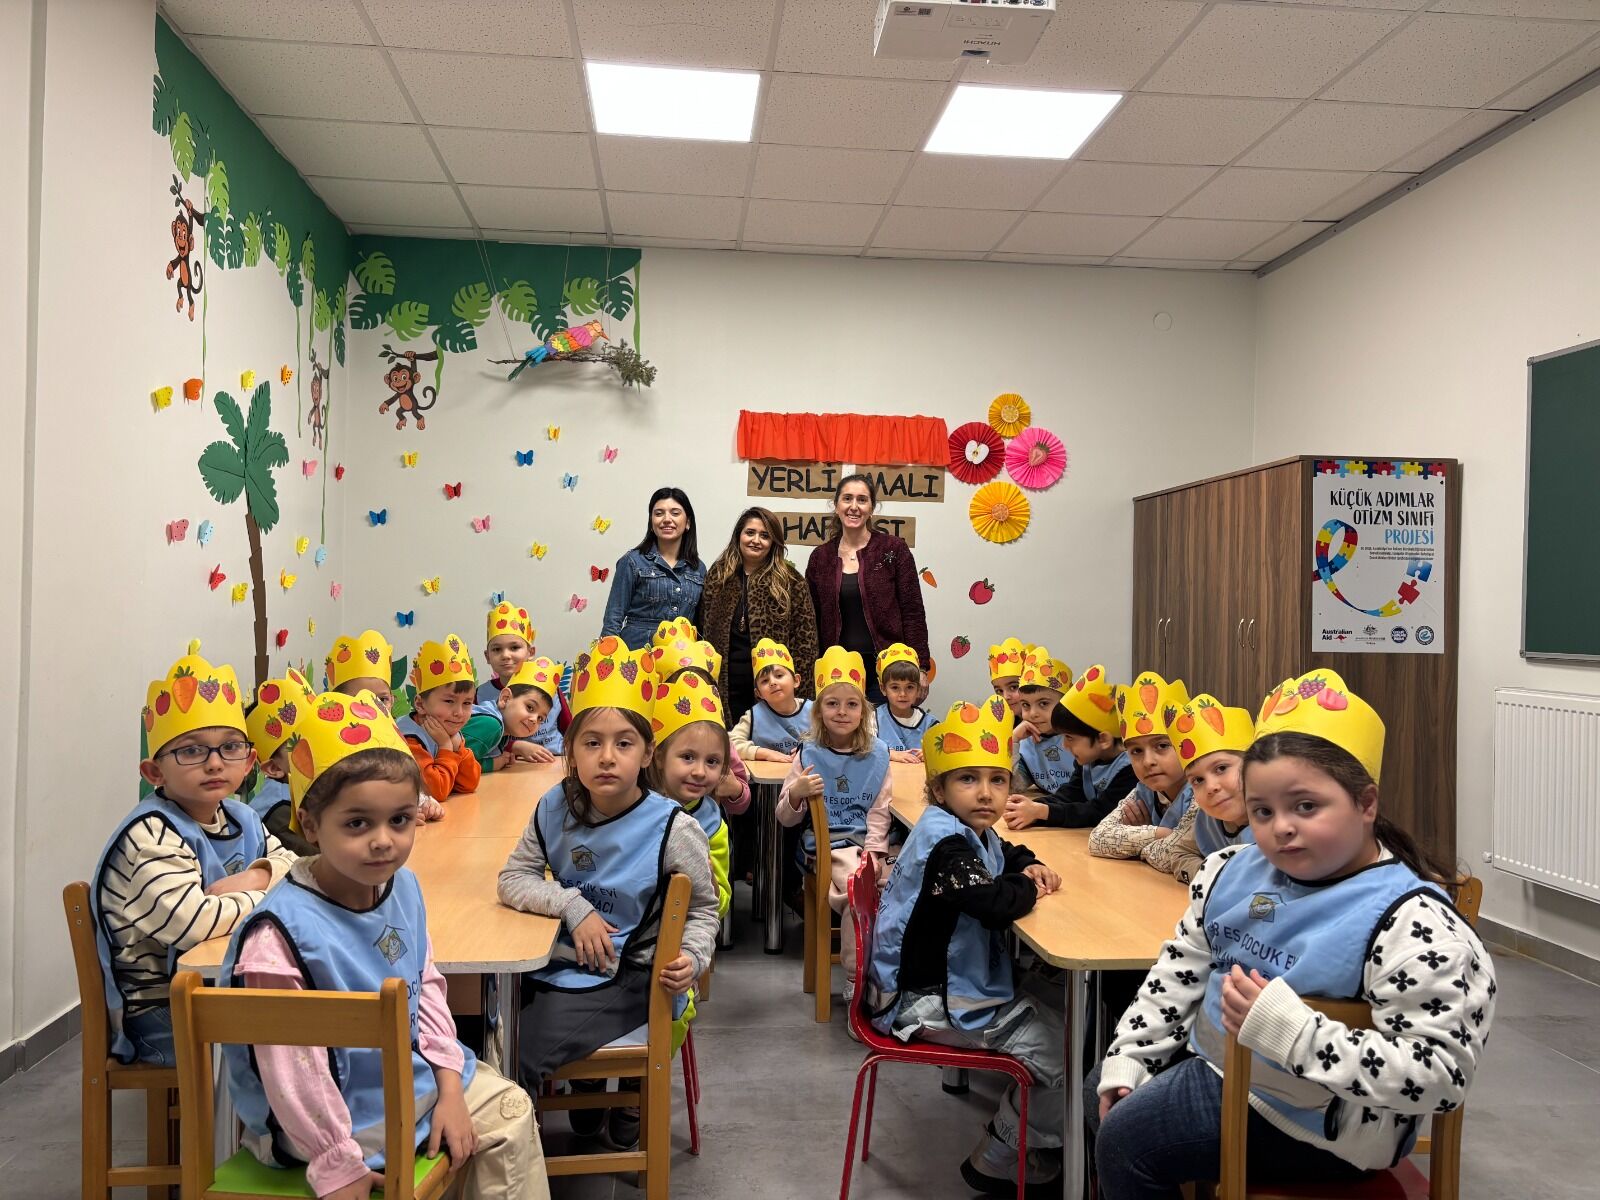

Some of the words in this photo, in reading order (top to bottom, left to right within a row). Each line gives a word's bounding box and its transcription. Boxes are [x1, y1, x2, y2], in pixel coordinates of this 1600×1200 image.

[751, 463, 837, 492] YERLİ
[1330, 488, 1372, 509] KÜÇÜK
[1376, 491, 1434, 508] ADIMLAR
[1353, 508, 1393, 525] OTİZM
[1397, 510, 1434, 526] SINIFI
[1385, 528, 1434, 545] PROJESİ
[1223, 926, 1241, 943] ES
